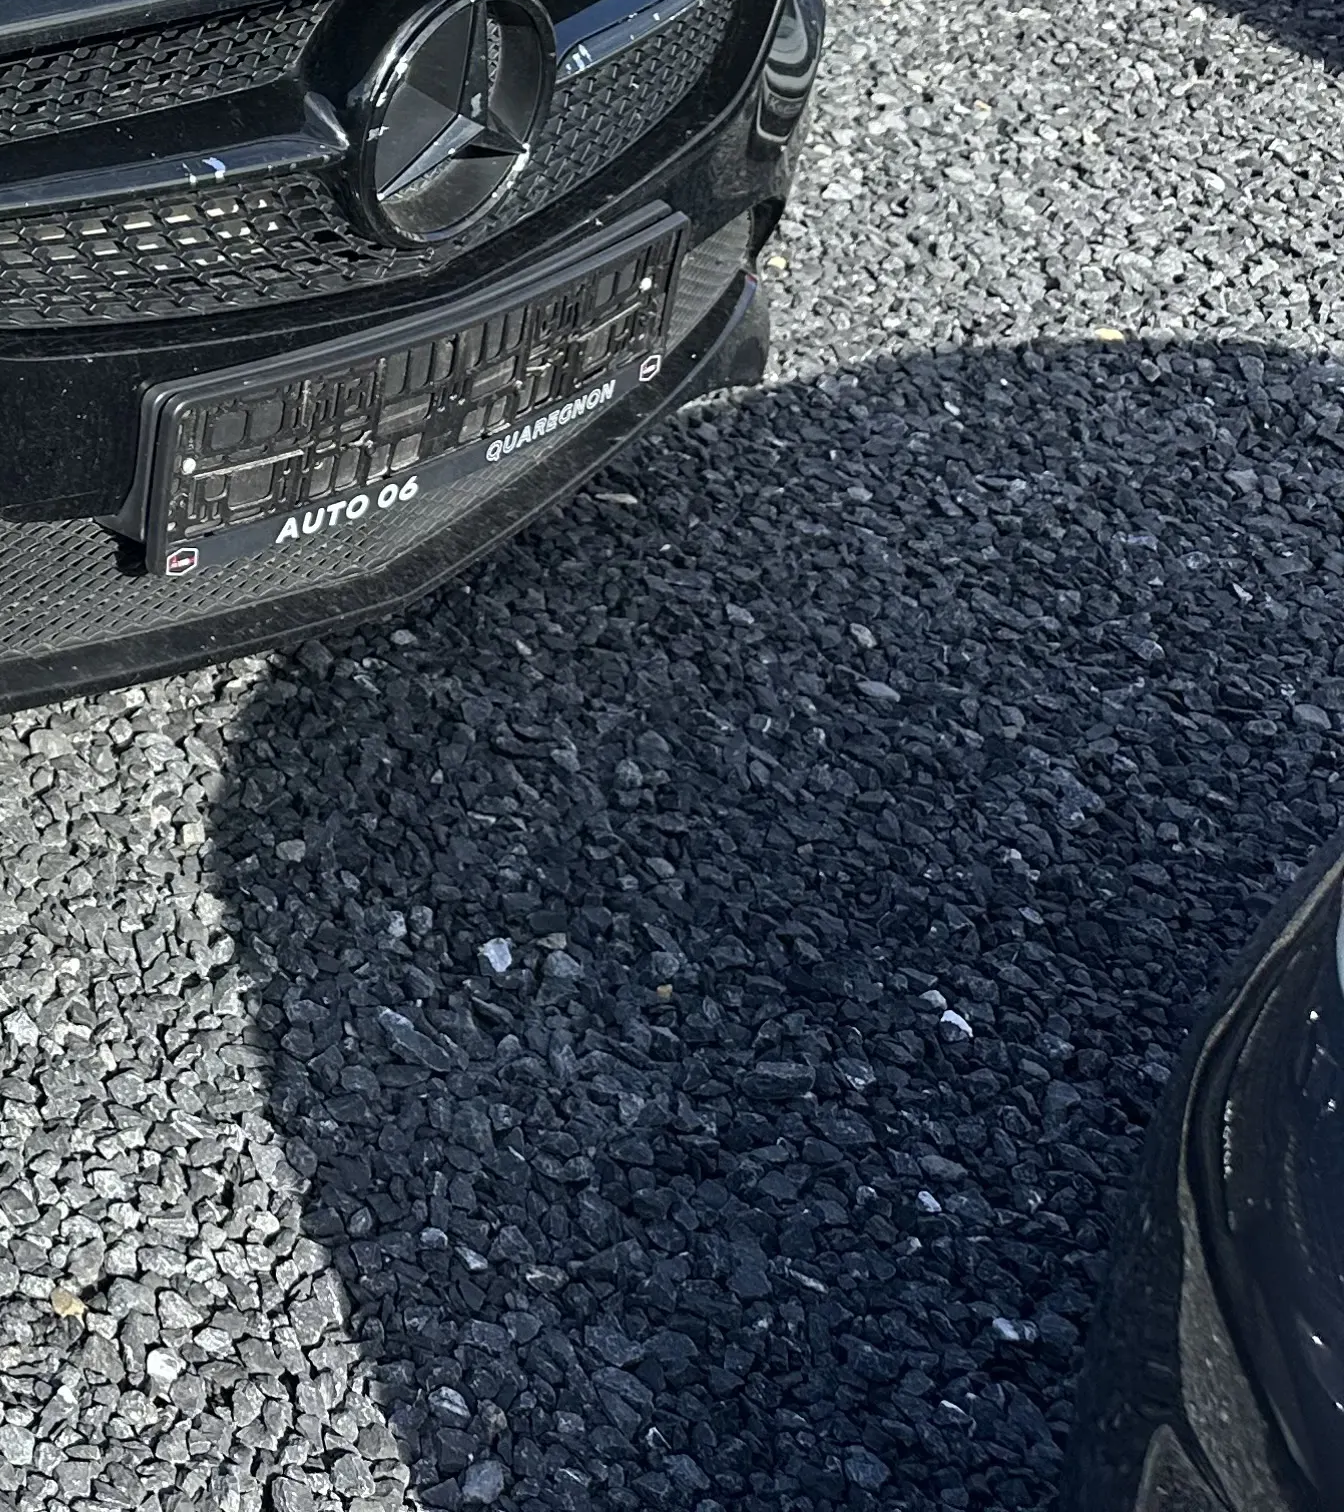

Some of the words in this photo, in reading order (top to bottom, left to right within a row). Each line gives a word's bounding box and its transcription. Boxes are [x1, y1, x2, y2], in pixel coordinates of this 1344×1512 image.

[486, 379, 616, 462] QUAREGNON
[275, 494, 370, 544] AUTO
[377, 475, 420, 509] 06
